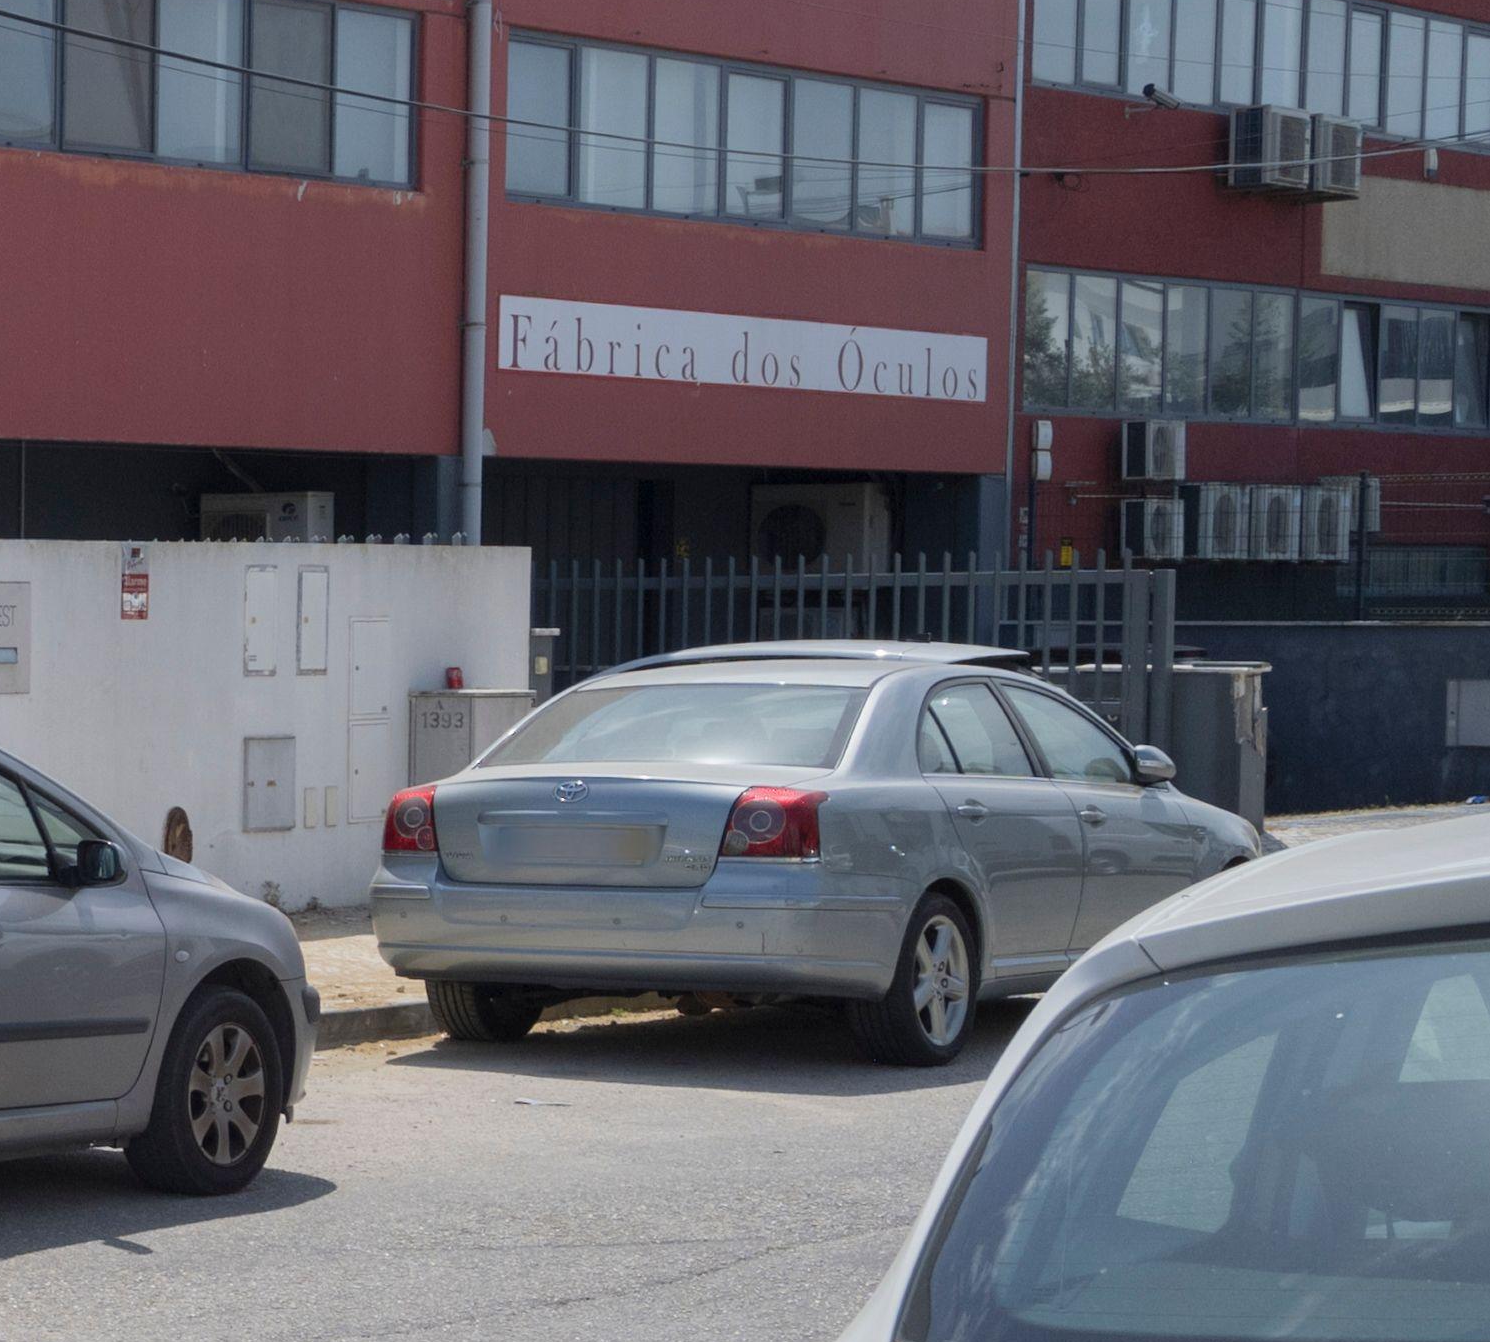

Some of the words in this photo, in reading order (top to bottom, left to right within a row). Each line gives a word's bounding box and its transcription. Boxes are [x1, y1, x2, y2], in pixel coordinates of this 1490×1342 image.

[509, 312, 698, 381] Fábrica
[731, 330, 802, 387] dos
[837, 327, 979, 400] Óculos
[420, 711, 464, 729] 1393
